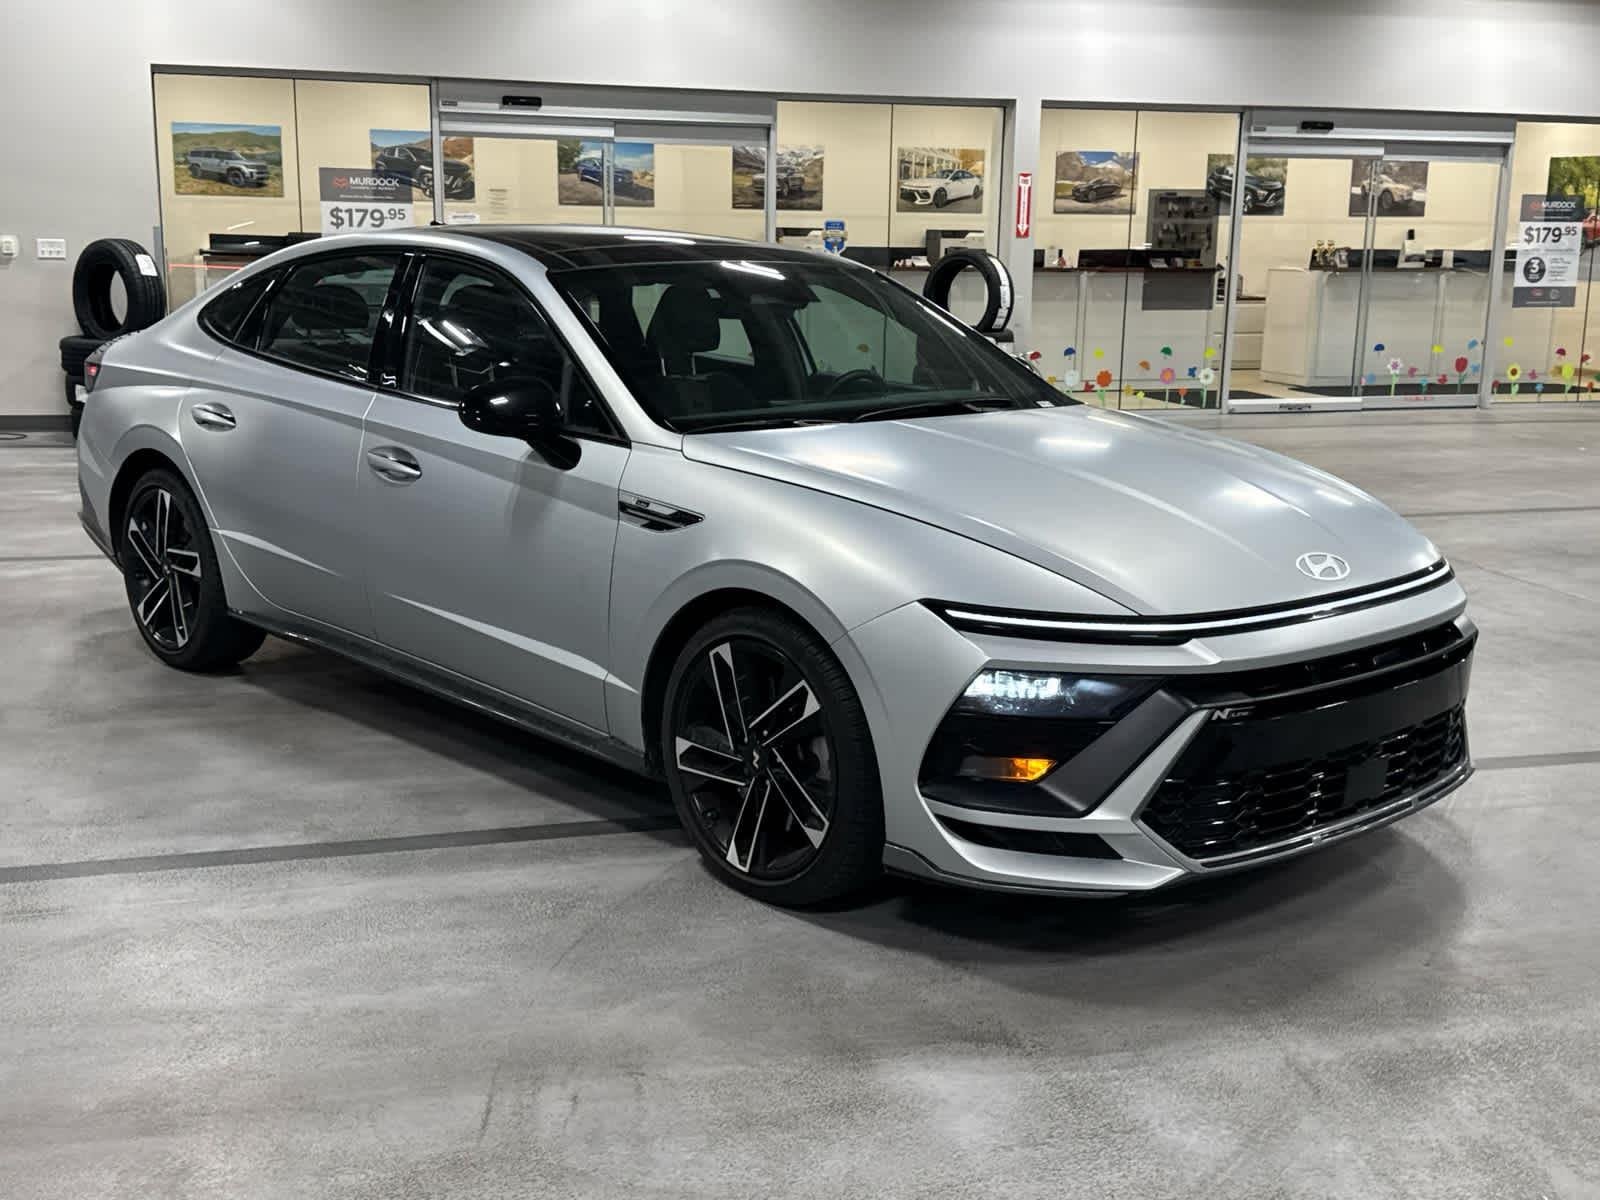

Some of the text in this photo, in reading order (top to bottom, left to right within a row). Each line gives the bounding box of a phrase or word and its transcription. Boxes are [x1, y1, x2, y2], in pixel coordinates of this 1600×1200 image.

[349, 176, 400, 187] MURDOCK
[329, 206, 406, 229] $179.95
[1524, 225, 1577, 245] $179.95
[1529, 259, 1540, 274] 3
[1211, 708, 1232, 720] N
